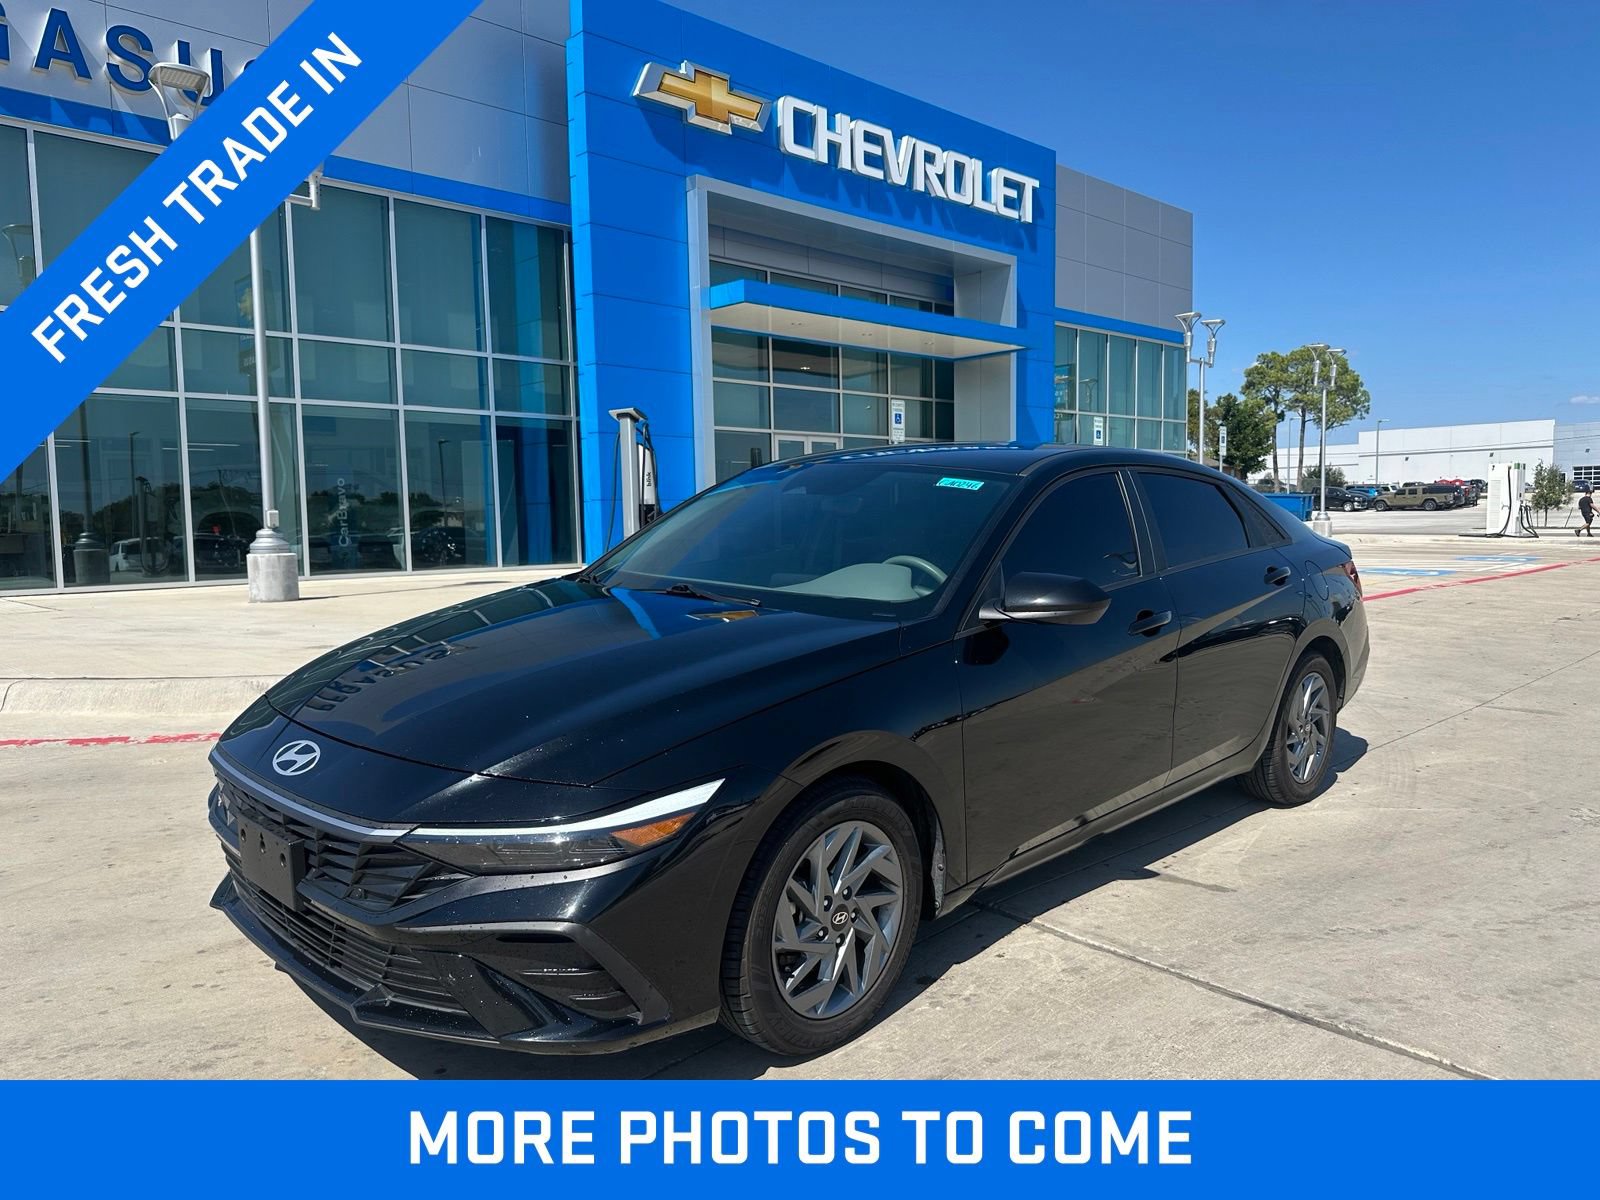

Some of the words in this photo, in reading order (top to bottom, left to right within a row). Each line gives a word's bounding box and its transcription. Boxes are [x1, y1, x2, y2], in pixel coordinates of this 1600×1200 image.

[0, 2, 257, 105] ASU
[778, 95, 1040, 223] CHEVROLET
[337, 478, 349, 547] CarBravo
